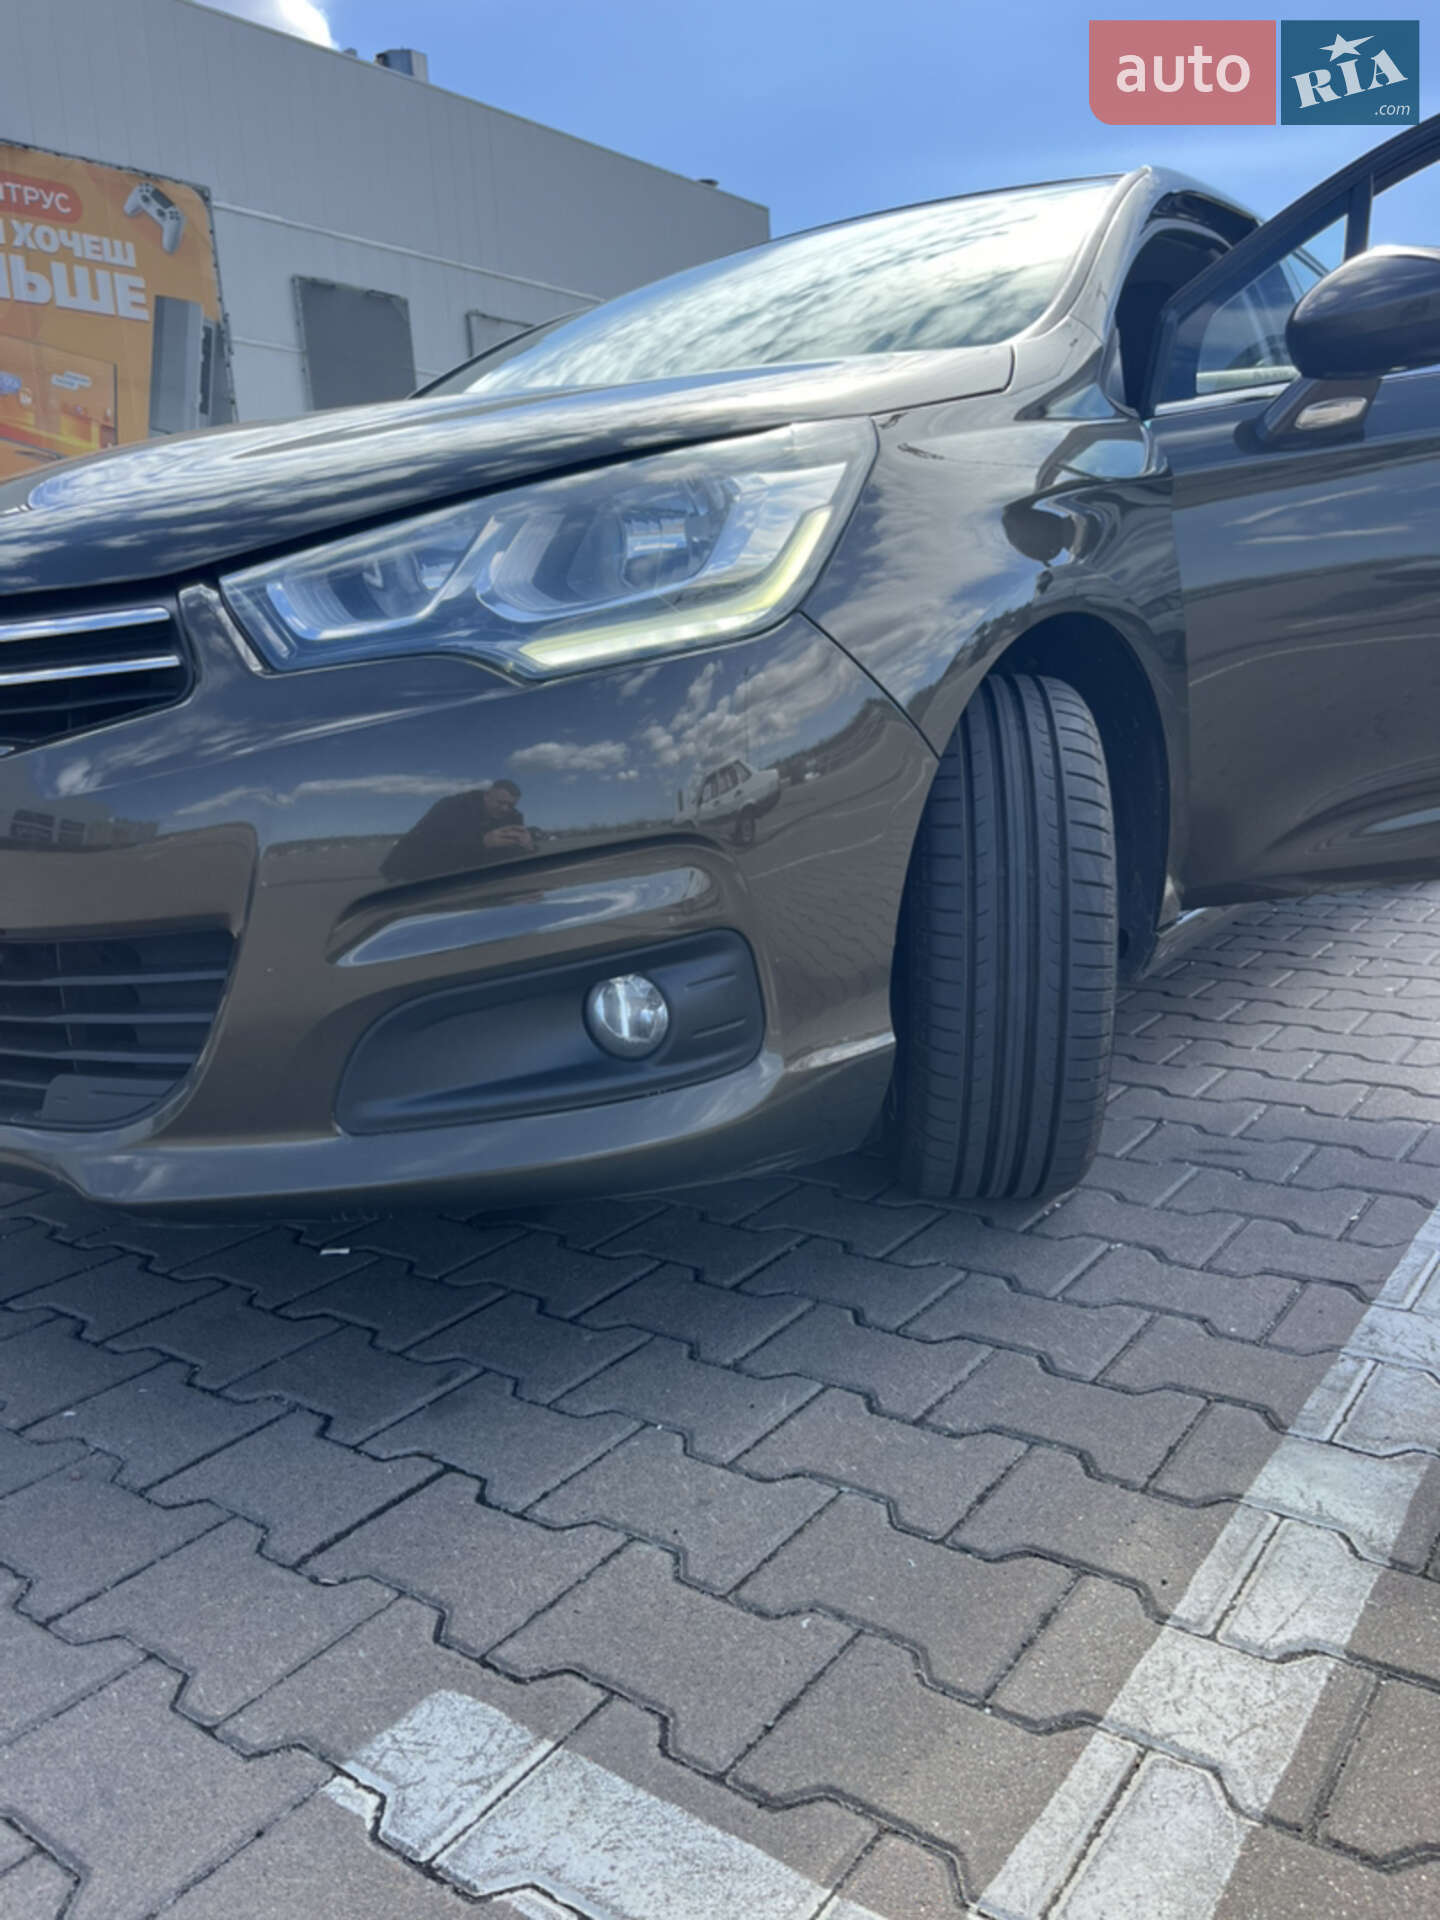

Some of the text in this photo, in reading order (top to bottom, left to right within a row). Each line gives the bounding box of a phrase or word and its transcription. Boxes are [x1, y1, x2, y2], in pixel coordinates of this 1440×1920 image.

[0, 181, 72, 214] ТРУС
[11, 219, 136, 268] ХОЧЕШ
[0, 252, 150, 321] ЬШЕ
